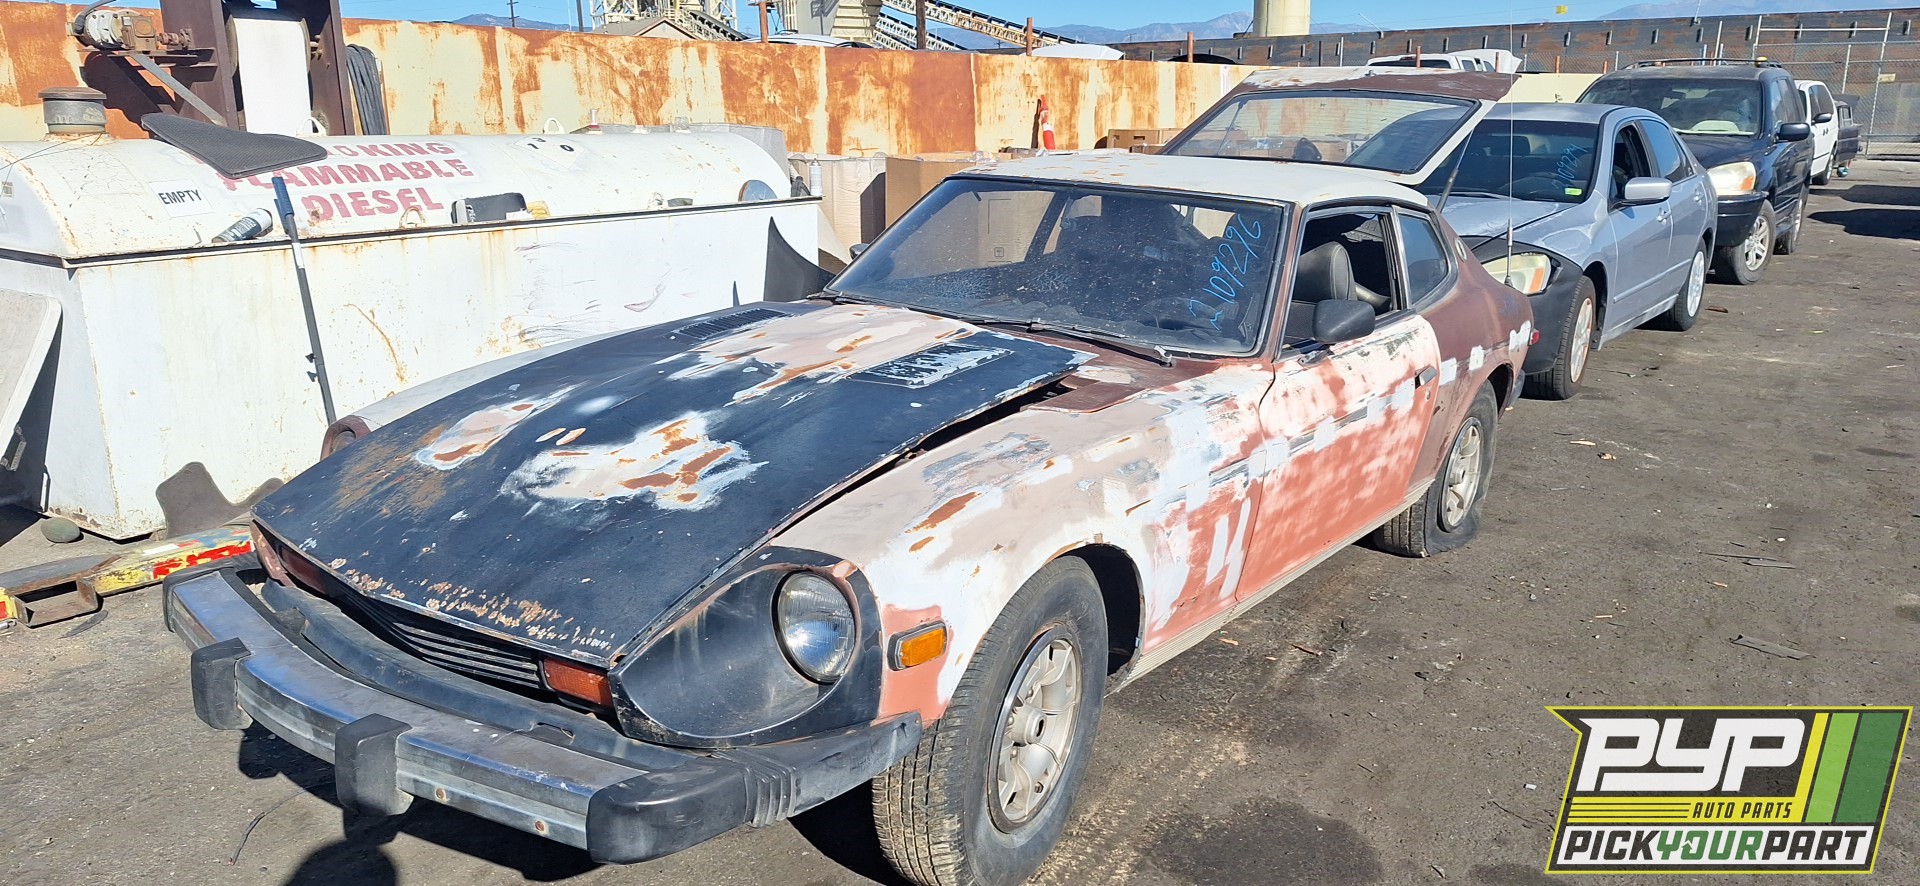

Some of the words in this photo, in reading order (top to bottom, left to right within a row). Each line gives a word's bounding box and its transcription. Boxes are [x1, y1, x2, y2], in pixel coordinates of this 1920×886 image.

[560, 144, 575, 152] 0
[158, 189, 203, 205] EMPTY
[301, 187, 444, 221] DIESEL
[1188, 213, 1262, 331] 2109296
